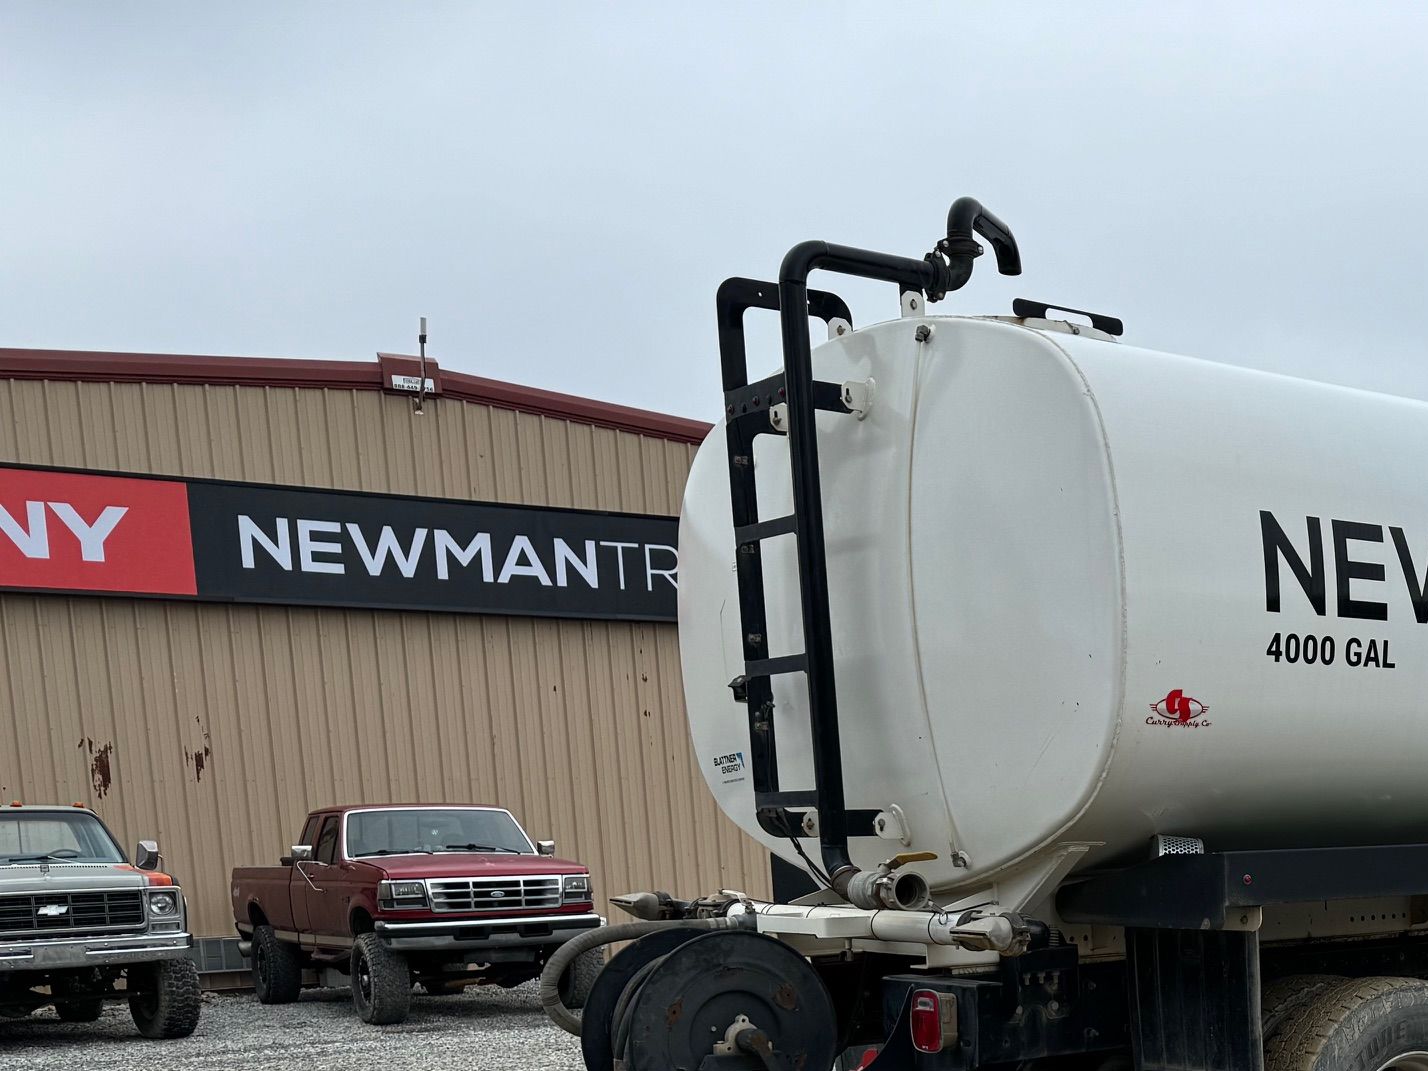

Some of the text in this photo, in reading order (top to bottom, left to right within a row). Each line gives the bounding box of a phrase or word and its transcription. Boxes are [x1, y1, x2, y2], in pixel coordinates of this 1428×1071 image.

[0, 500, 129, 563] NY
[1266, 632, 1396, 669] 4000 GAL
